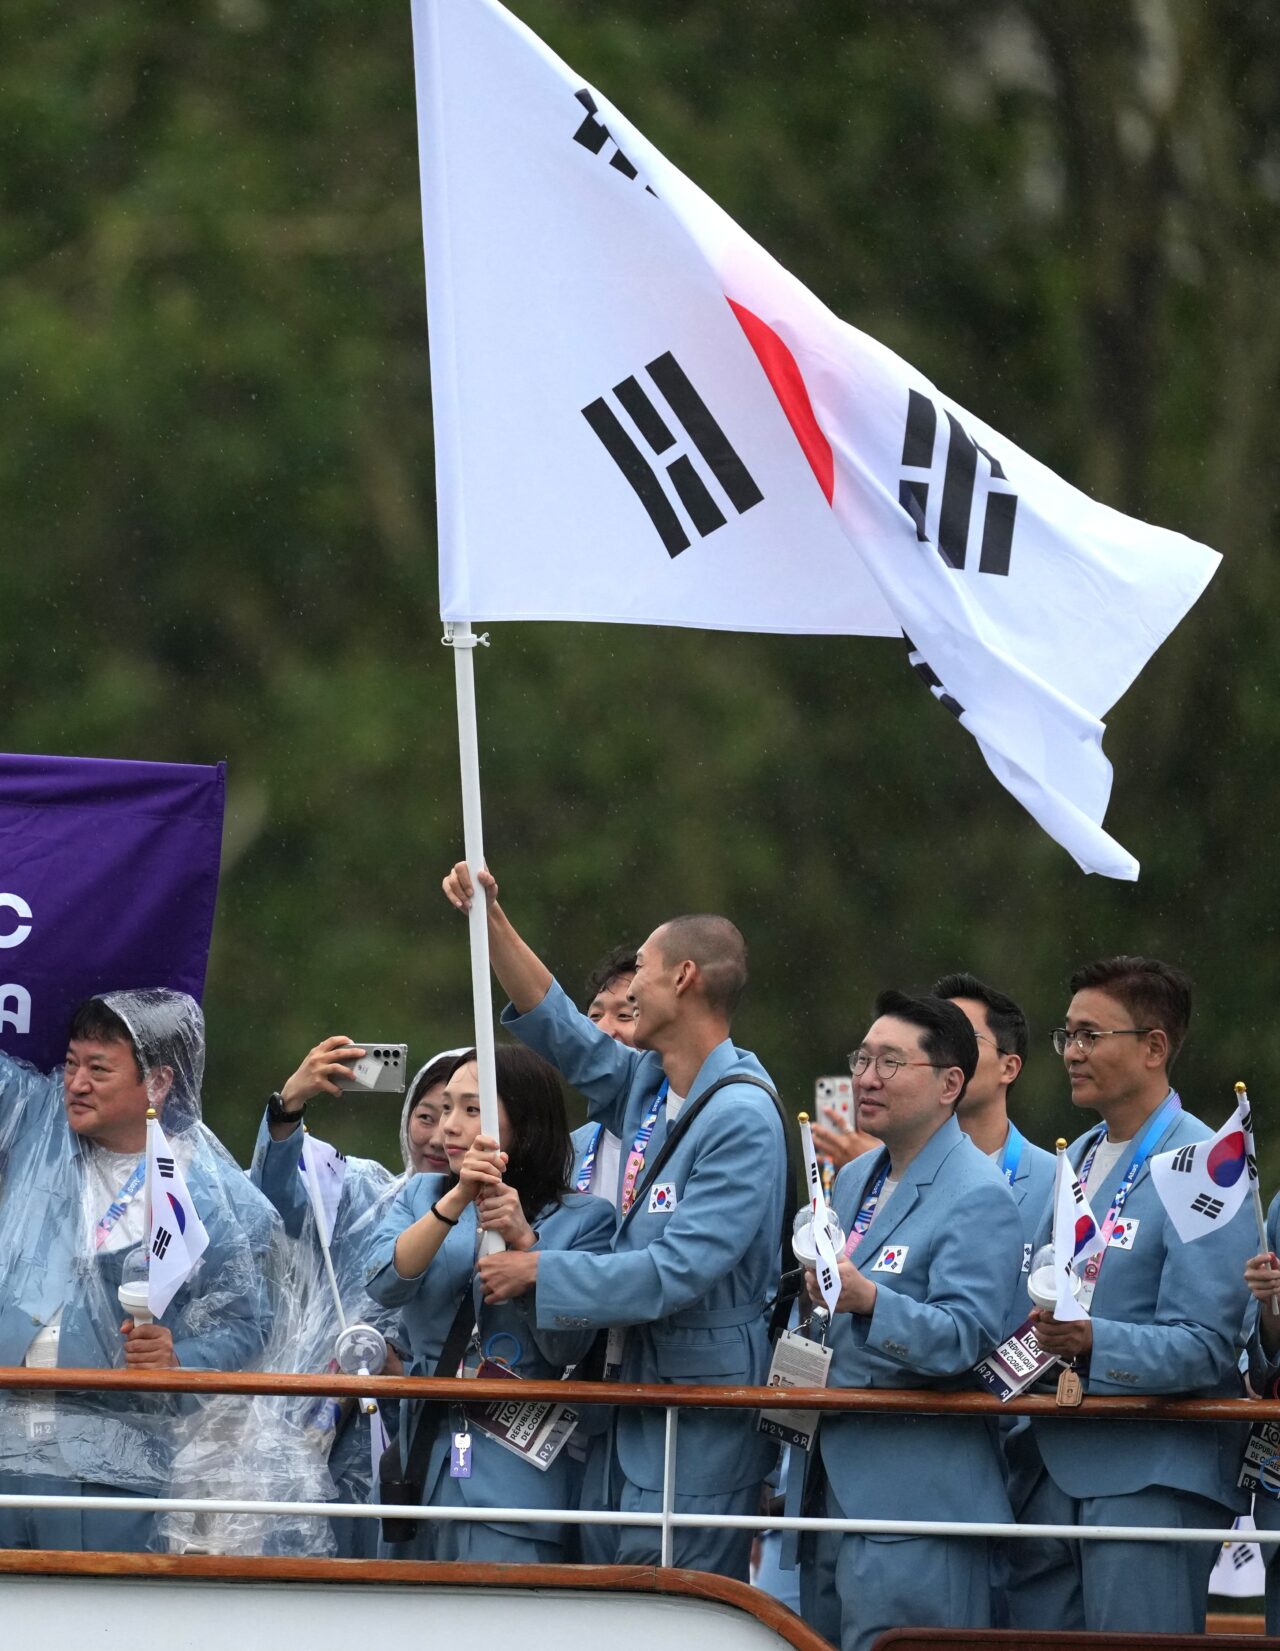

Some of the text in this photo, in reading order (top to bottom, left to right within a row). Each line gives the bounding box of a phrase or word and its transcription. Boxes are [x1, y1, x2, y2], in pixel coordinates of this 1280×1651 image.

[1000, 1348, 1009, 1357] DE
[1007, 1340, 1035, 1370] RÉPUBLIQUE
[520, 1404, 548, 1442] DE CORÉE
